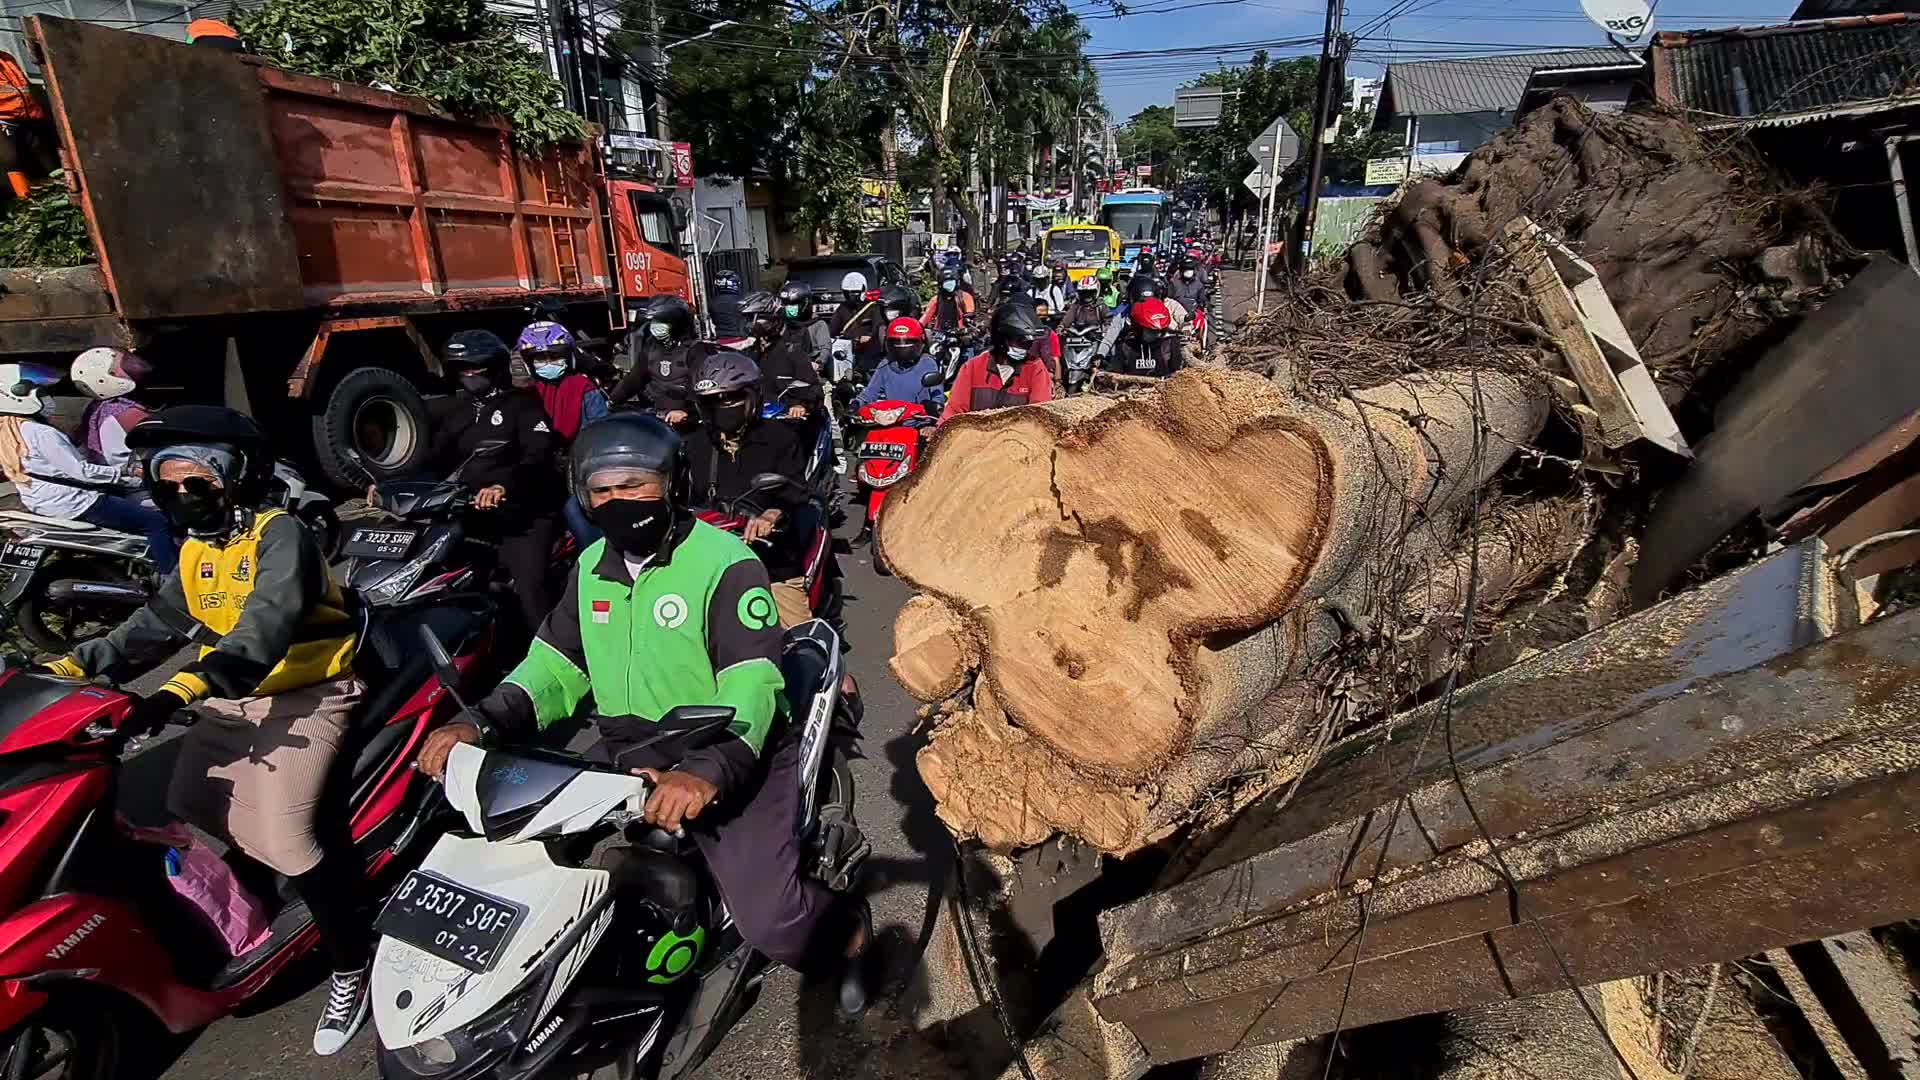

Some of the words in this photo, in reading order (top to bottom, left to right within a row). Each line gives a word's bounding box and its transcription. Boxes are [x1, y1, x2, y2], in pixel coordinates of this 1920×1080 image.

[625, 252, 652, 271] 0997
[634, 274, 643, 292] S
[352, 532, 362, 542] B
[366, 532, 391, 544] 3232
[6, 544, 14, 554] B
[397, 877, 418, 901] B
[415, 884, 467, 919] 3537
[45, 913, 107, 959] YAMAHA
[524, 1014, 565, 1054] YAMAHA
